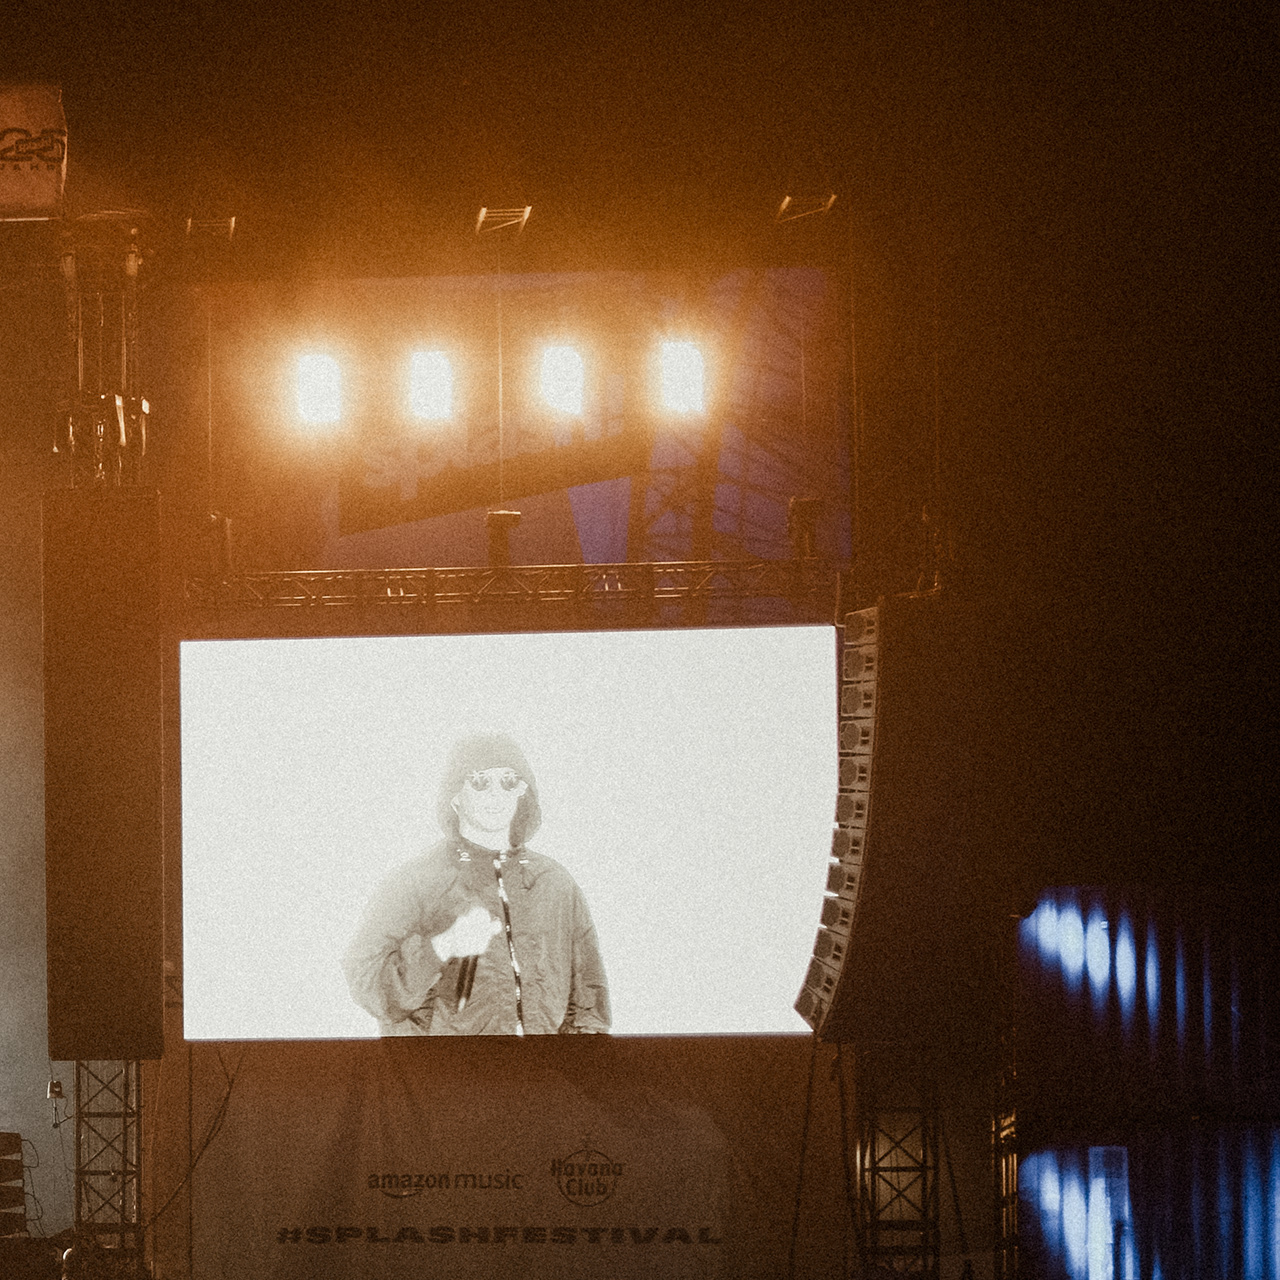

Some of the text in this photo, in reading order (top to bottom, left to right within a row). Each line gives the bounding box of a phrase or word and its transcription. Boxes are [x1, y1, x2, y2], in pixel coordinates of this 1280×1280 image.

[550, 1157, 624, 1177] Havana
[368, 1168, 525, 1191] amazon music
[565, 1178, 608, 1197] Club
[277, 1225, 722, 1246] #SPLASHFESTIVAL
